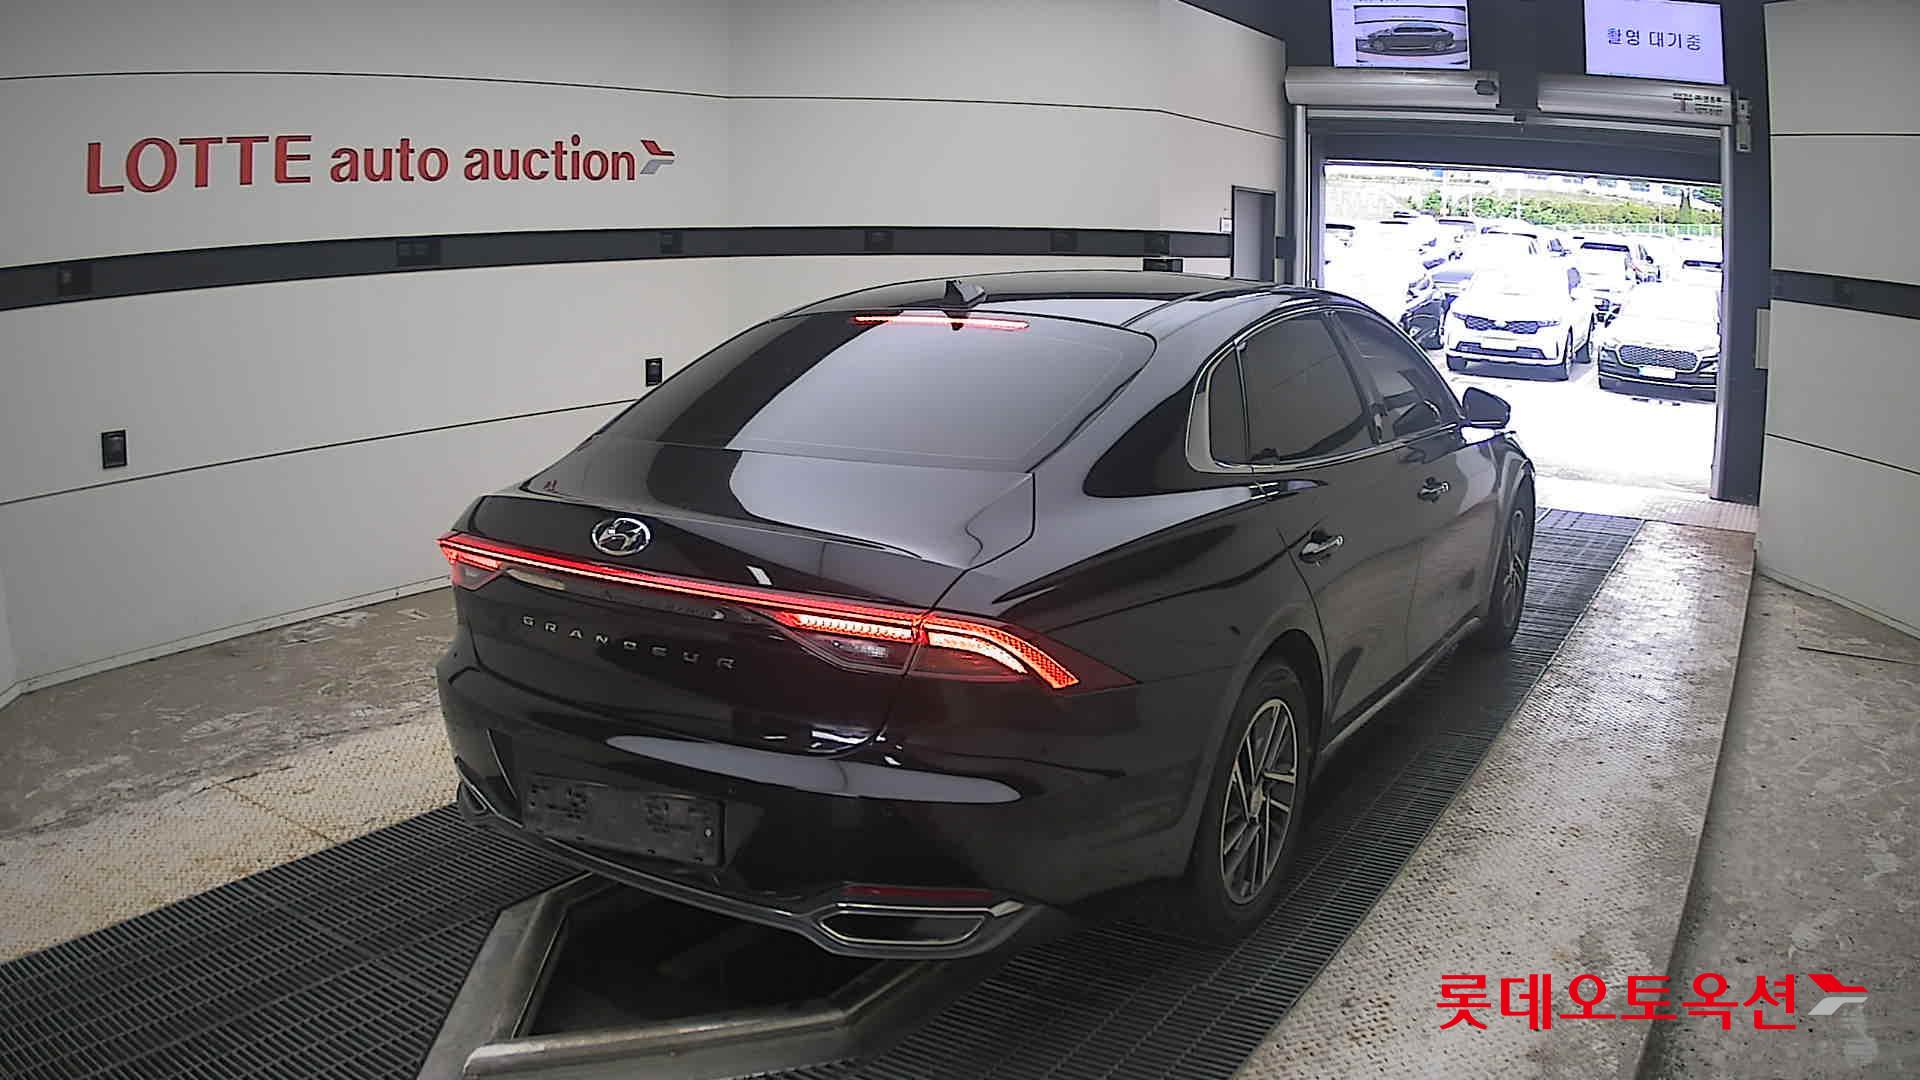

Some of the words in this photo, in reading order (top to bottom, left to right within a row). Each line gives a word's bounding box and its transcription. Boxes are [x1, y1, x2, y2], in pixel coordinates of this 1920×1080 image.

[86, 134, 312, 194] LOTTE
[329, 138, 451, 183] auto
[463, 134, 637, 182] auction
[522, 616, 737, 670] GRANDEUR
